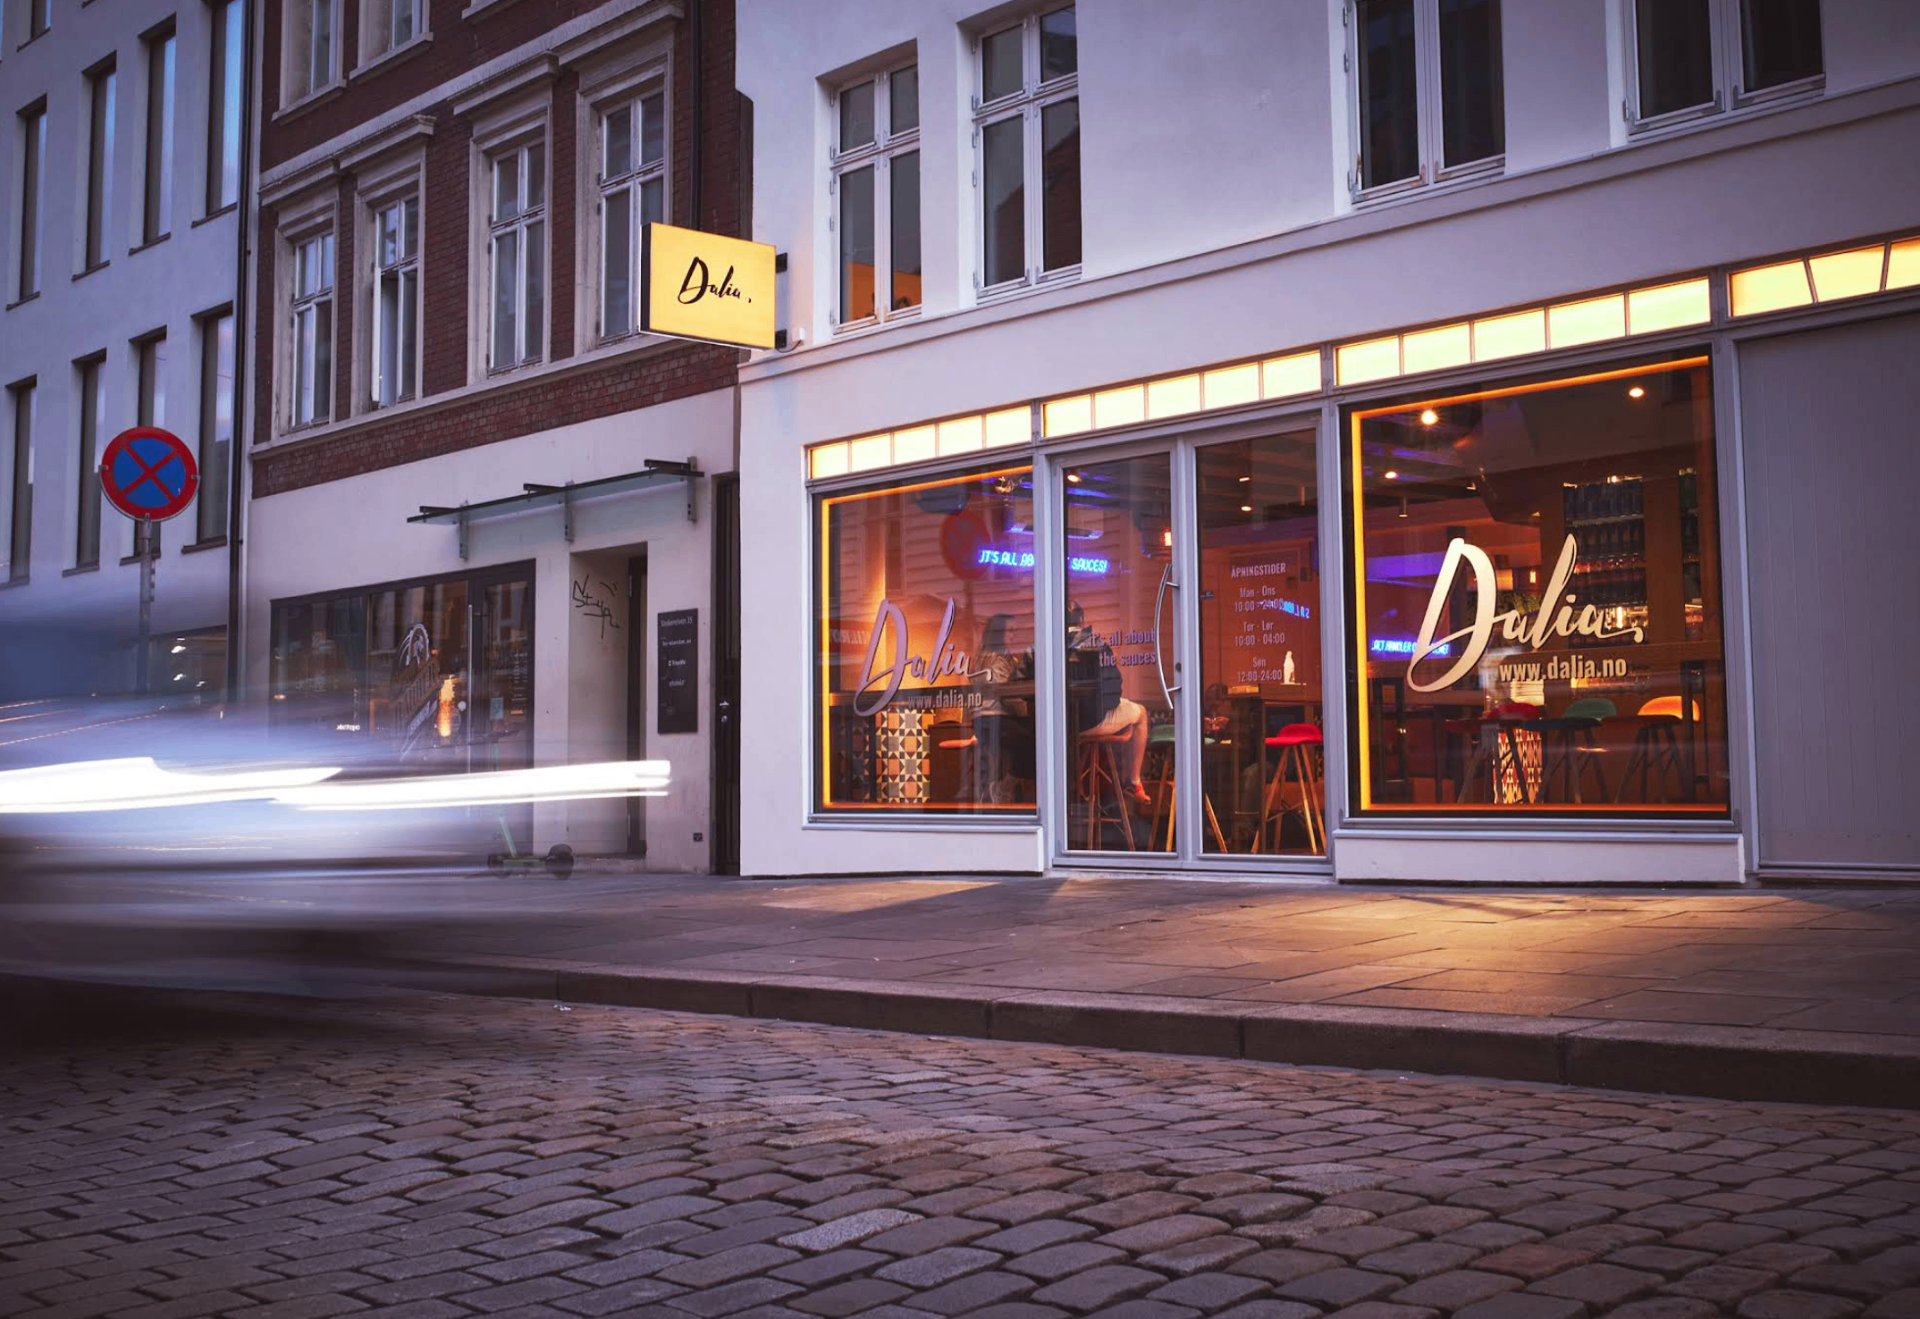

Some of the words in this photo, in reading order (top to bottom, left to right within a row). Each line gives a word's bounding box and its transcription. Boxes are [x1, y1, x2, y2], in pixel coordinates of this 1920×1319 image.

[978, 549, 999, 564] IT'S
[999, 551, 1018, 566] ALL
[1239, 588, 1255, 598] Man
[1261, 585, 1276, 596] Ons
[1234, 600, 1255, 612] 10:00
[1407, 533, 1646, 693] Dalia
[1243, 621, 1254, 632] Tor
[1109, 630, 1122, 645] all
[1125, 628, 1155, 644] about
[1235, 636, 1256, 647] 10:00
[1262, 633, 1285, 645] 04:00
[853, 596, 994, 716] Dalia
[1099, 652, 1116, 666] the
[1120, 652, 1156, 666] sauces
[1499, 656, 1627, 682] www.dalia.no
[908, 689, 982, 708] www.dalia.no
